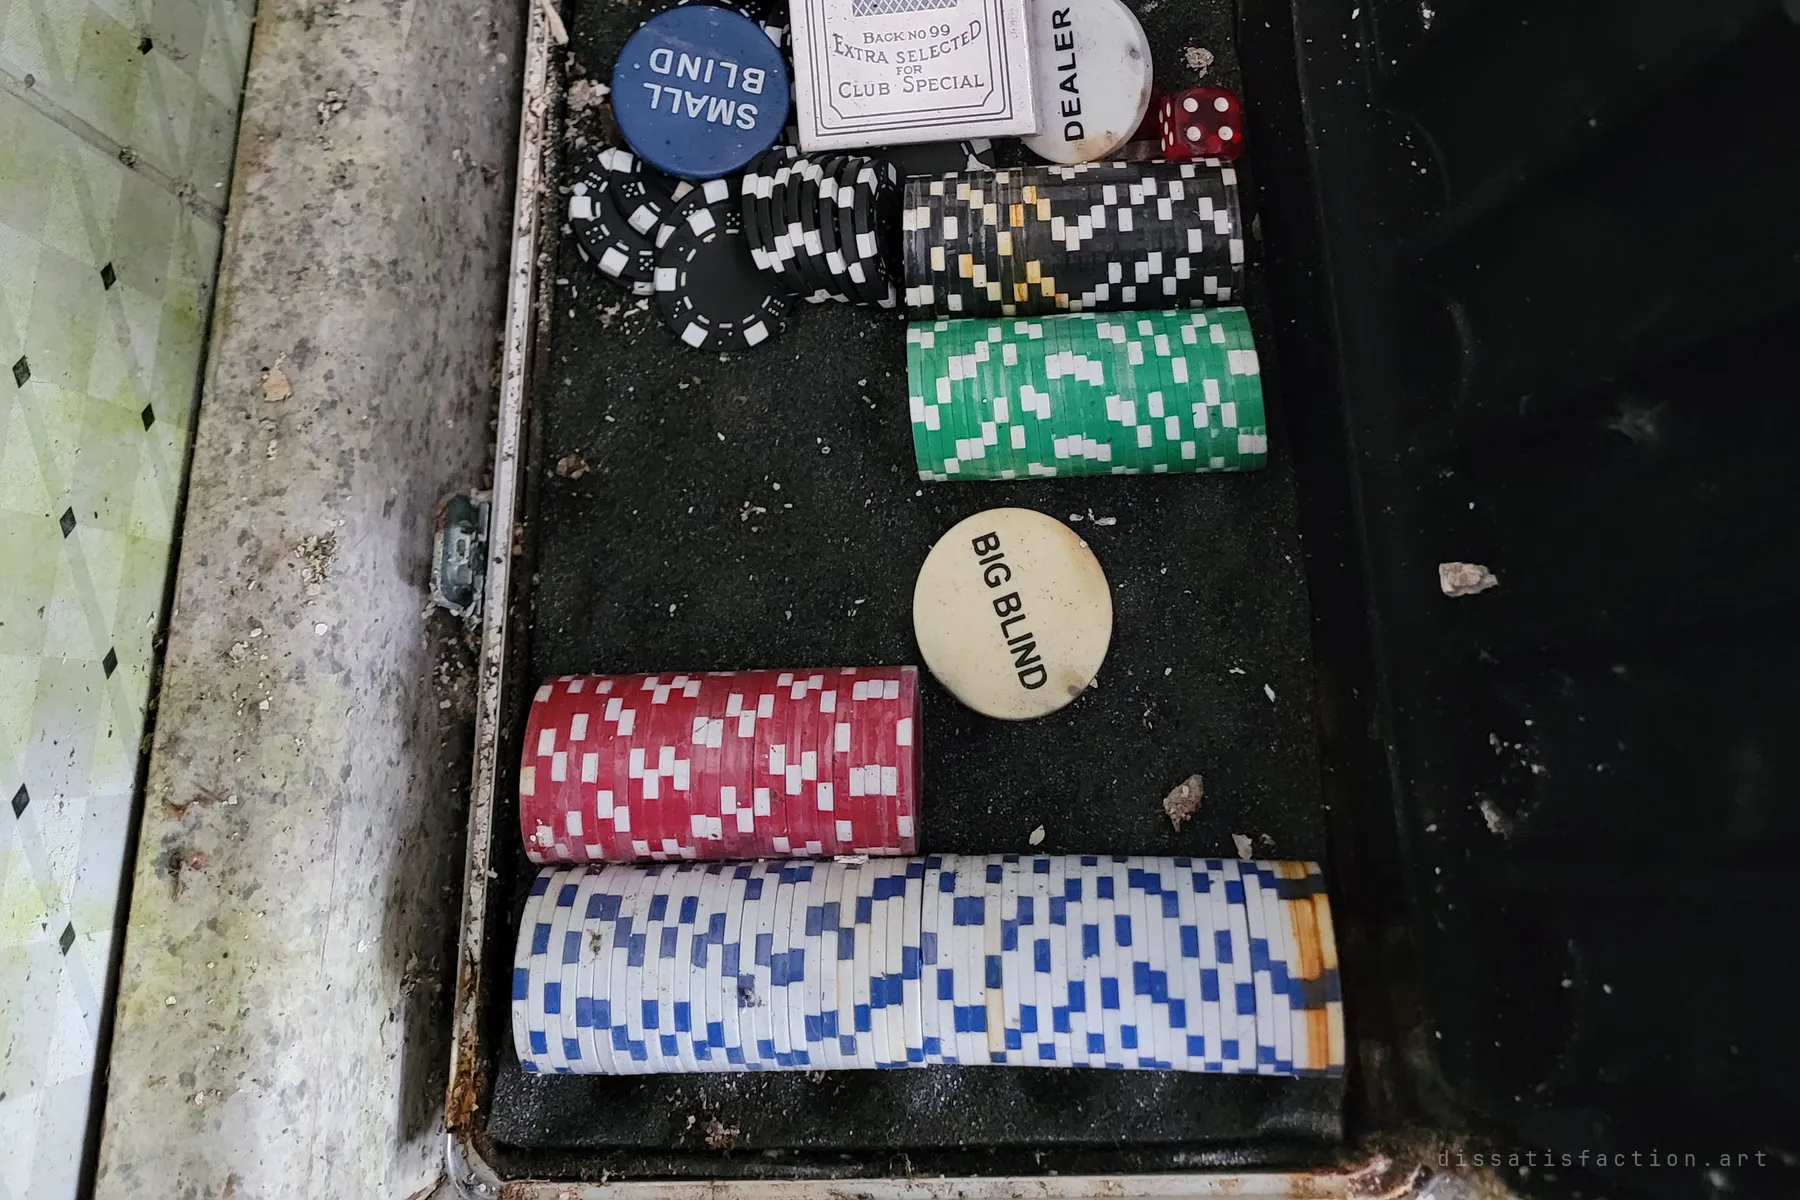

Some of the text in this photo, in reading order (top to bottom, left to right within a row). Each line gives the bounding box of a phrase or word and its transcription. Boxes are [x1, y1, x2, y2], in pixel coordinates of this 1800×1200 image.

[832, 20, 982, 64] EXTRA SELECTED
[863, 31, 905, 44] BACK
[929, 24, 950, 38] 99
[649, 48, 766, 105] BLIND
[838, 74, 985, 99] CLUB SPECIAL
[896, 65, 922, 76] FOR
[1052, 7, 1084, 141] DEALER
[643, 82, 758, 130] SMALL
[971, 531, 1048, 690] BIG BLIND
